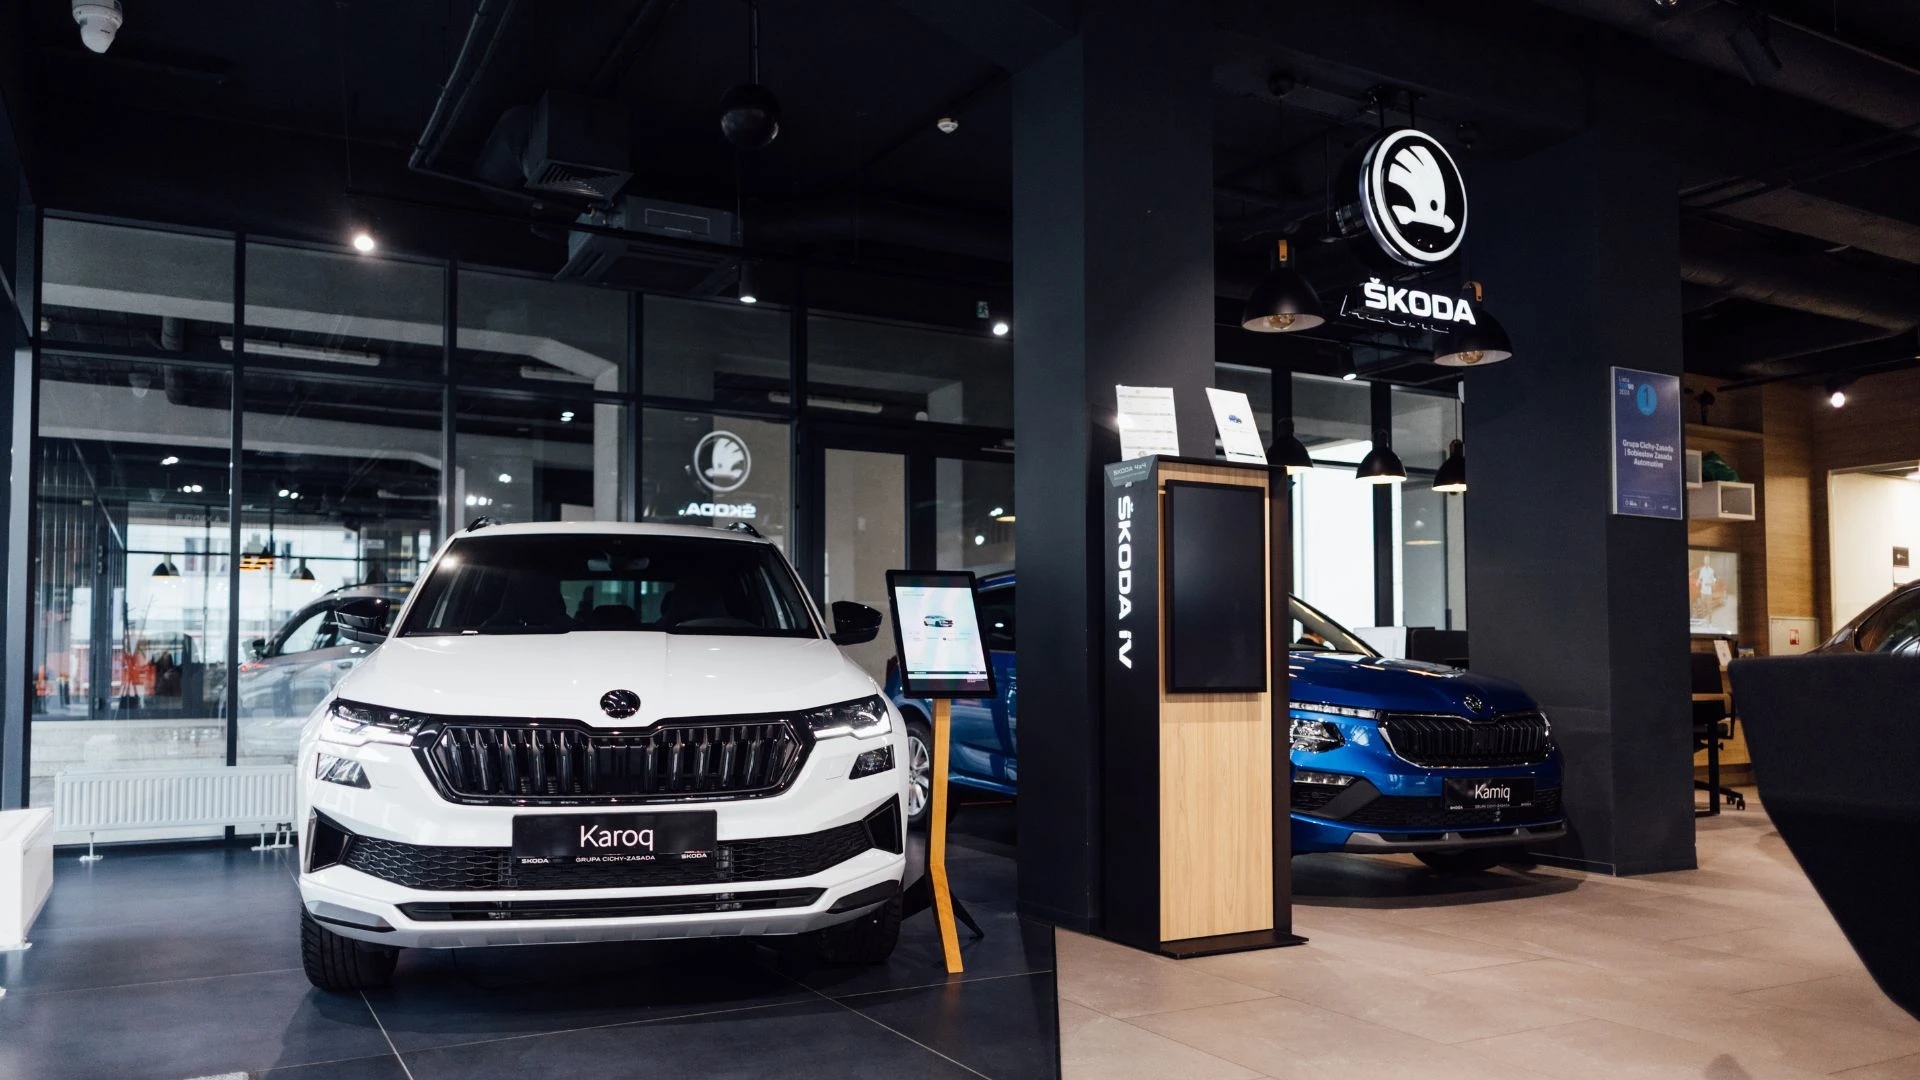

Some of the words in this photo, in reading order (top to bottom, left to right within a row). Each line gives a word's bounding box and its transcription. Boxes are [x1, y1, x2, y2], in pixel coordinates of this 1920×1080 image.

[1363, 277, 1477, 326] ŠKODA
[1622, 439, 1639, 448] Grupa
[1640, 441, 1674, 452] Cichy-Zasada
[1633, 457, 1664, 469] Automotive
[1654, 451, 1673, 461] Zasada
[1117, 495, 1134, 621] ŠKODA
[1475, 783, 1511, 803] Kamiq
[579, 824, 654, 852] Karoq
[602, 854, 656, 863] CICHY-ZASADA
